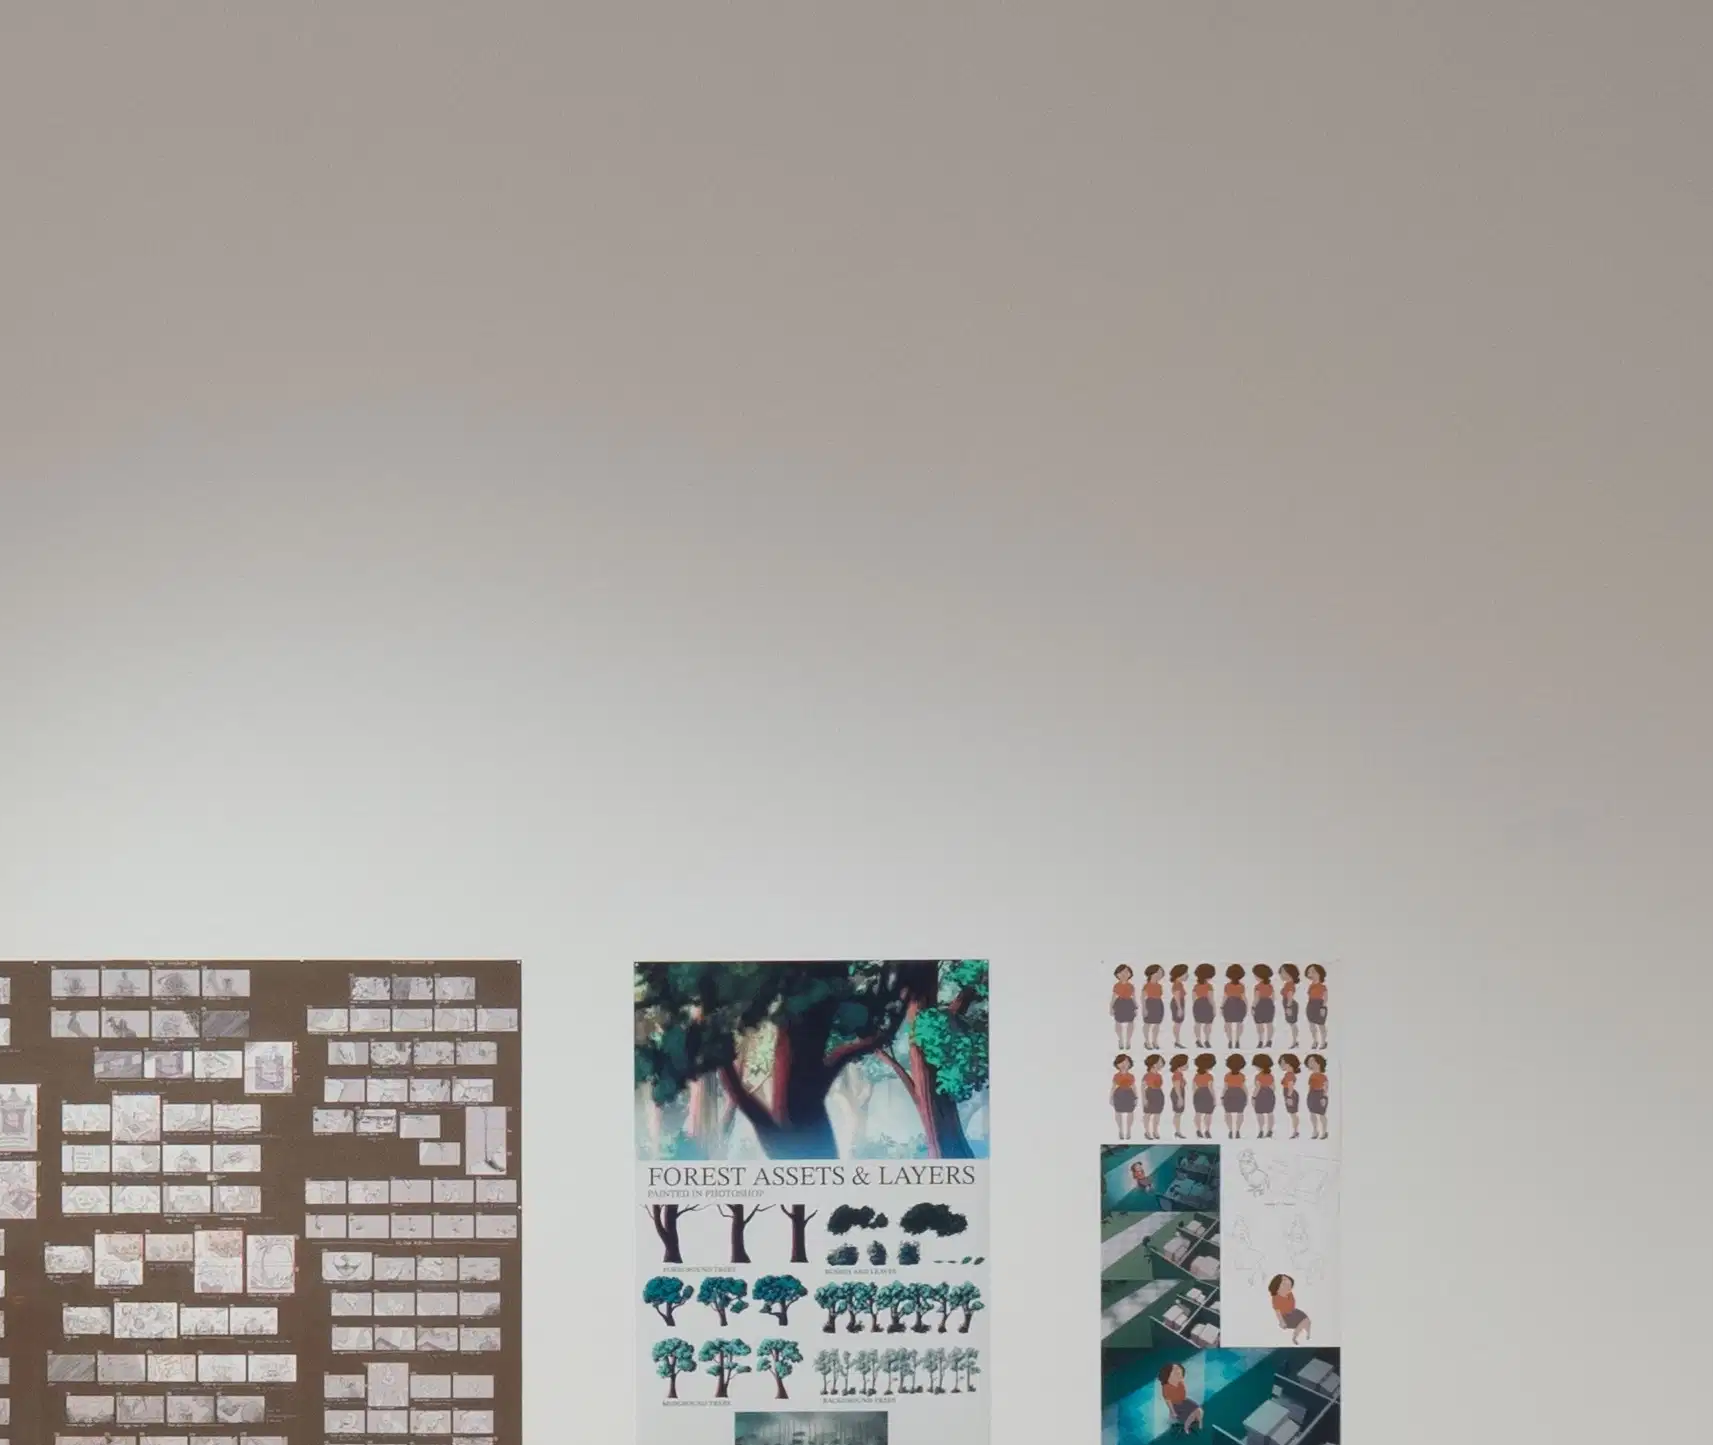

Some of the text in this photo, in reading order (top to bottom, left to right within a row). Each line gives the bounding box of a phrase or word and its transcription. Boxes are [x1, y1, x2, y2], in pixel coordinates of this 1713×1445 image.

[648, 1165, 976, 1186] FOREST ASSETS & LAYERS
[647, 1188, 764, 1198] PAINTED IN PHOTOSHOP
